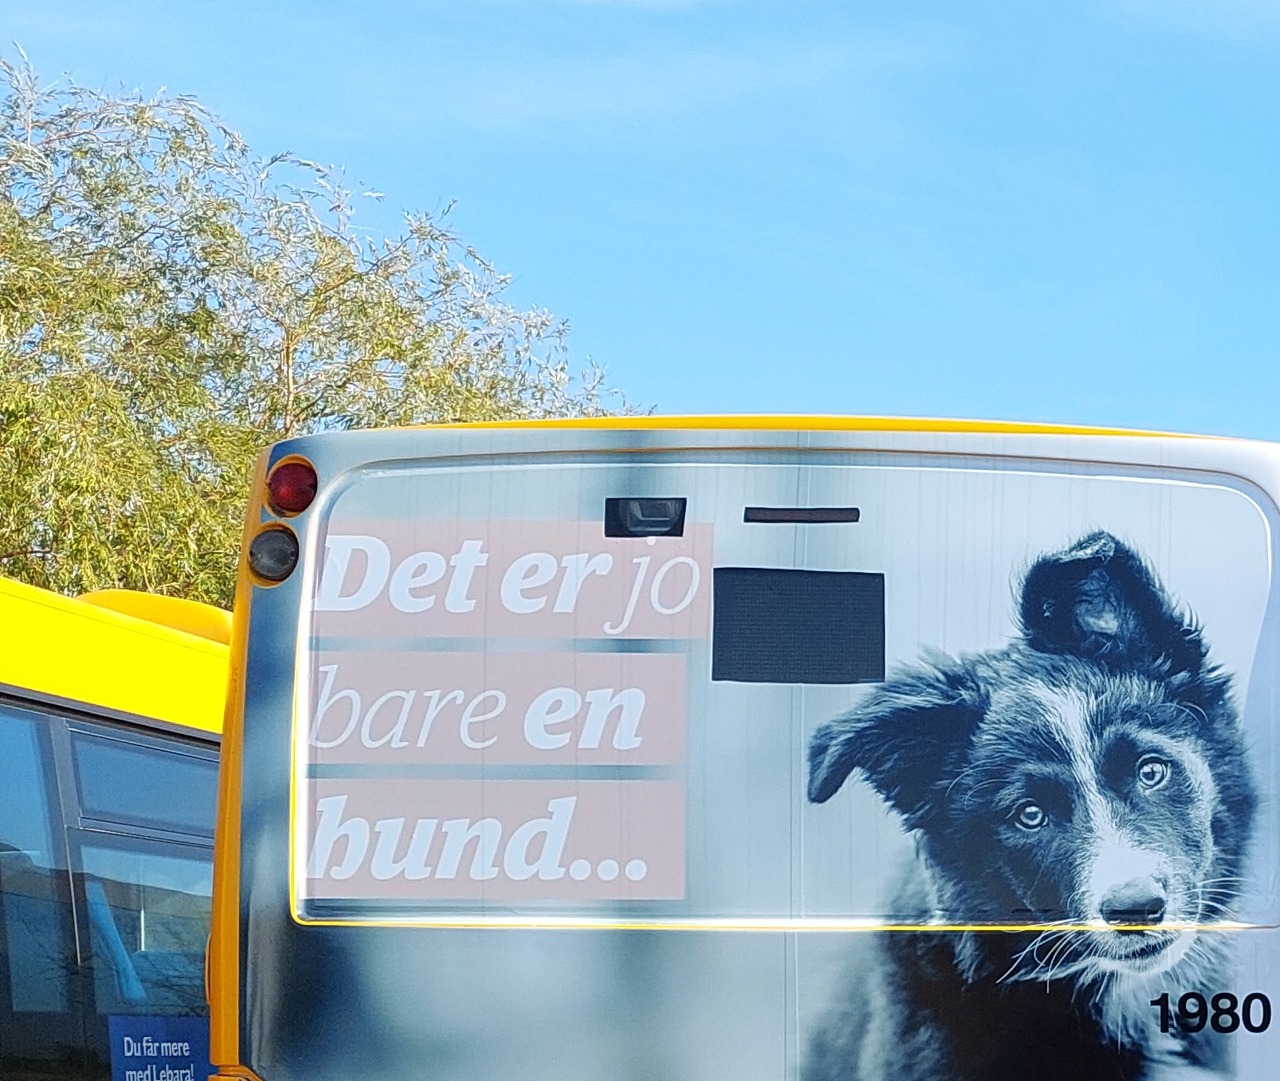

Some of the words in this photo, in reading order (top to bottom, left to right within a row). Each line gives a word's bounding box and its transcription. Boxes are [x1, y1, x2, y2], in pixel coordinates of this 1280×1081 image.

[310, 535, 489, 613] Det
[501, 552, 613, 614] er
[603, 536, 700, 634] jo
[308, 664, 506, 748] bare
[524, 687, 645, 749] en
[306, 795, 647, 881] hund...
[124, 1037, 141, 1056] Du
[143, 1037, 158, 1056] får
[161, 1042, 190, 1056] mere
[1150, 992, 1272, 1033] 1980
